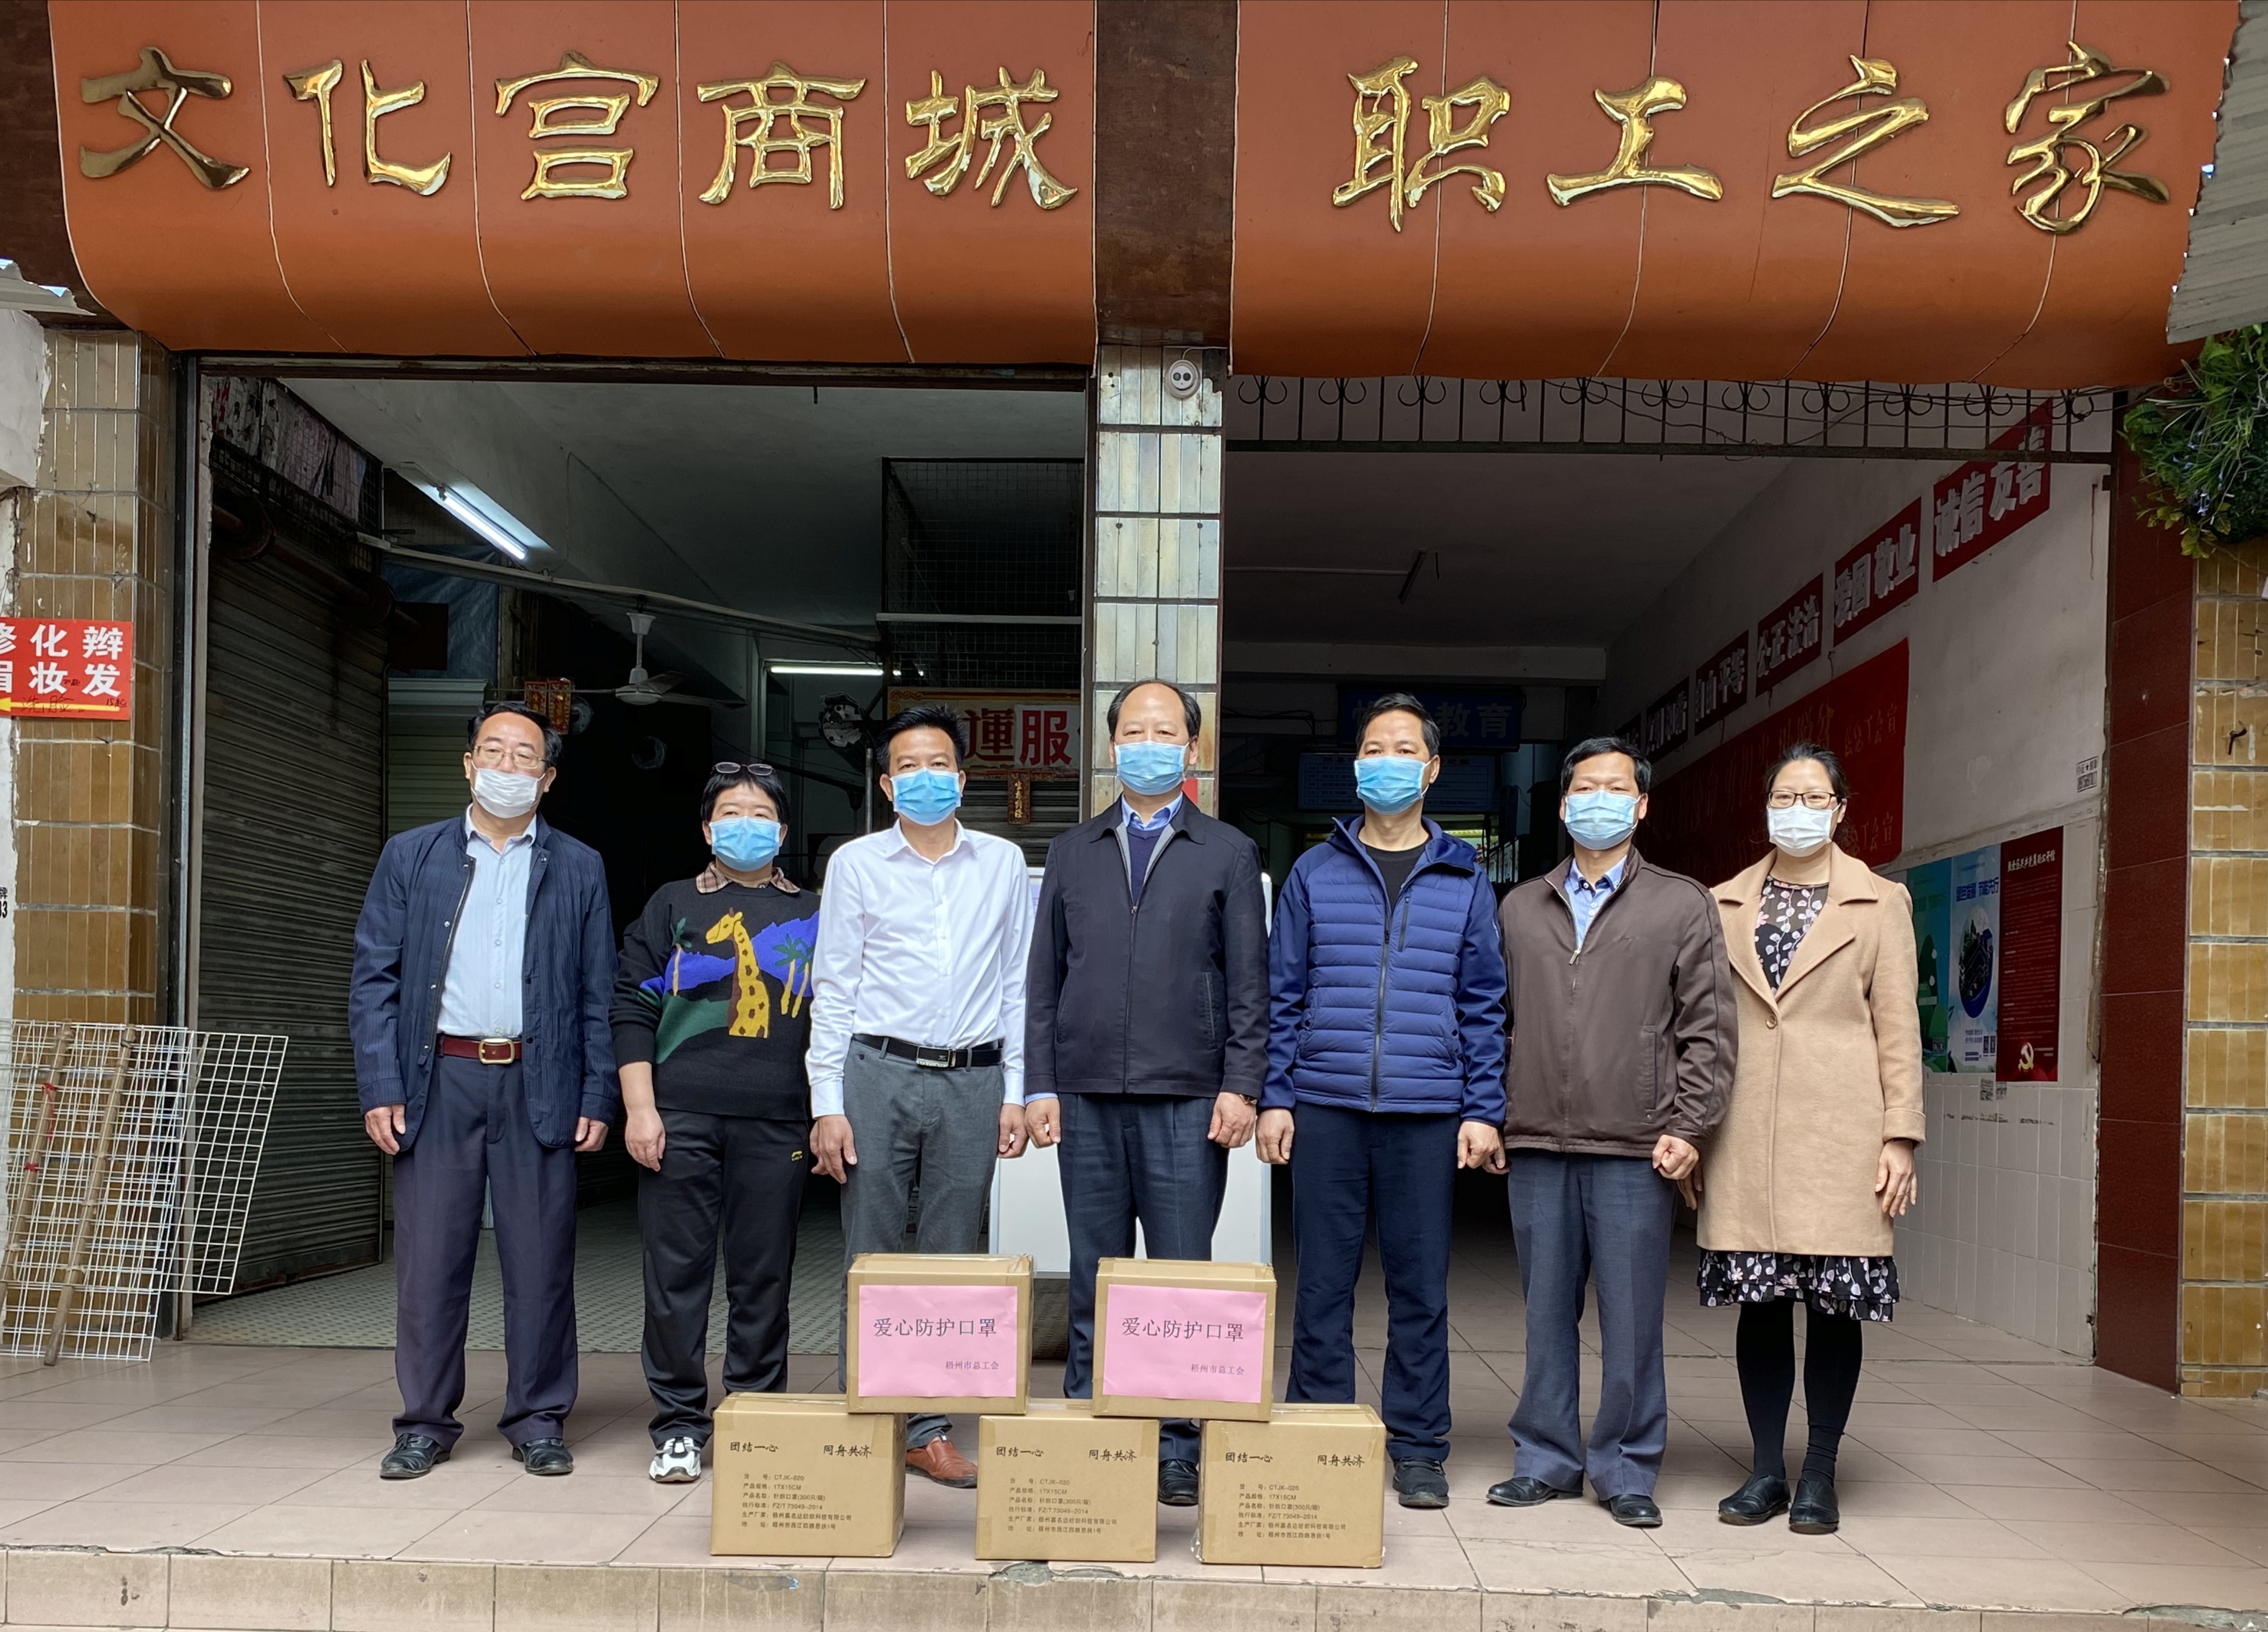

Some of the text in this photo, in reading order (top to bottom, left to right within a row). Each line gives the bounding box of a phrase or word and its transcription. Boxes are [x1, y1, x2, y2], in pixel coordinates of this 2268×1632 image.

[79, 45, 1078, 210] 文化宫商城
[1331, 39, 2172, 235] 职工之家
[873, 1316, 997, 1338] 爱心防护口罩
[1121, 1316, 1244, 1342] 爱心防护口罩
[945, 1360, 1000, 1370] 梧州市总工会
[1190, 1362, 1244, 1376] 梧州市总工会
[730, 1441, 872, 1458] 团结一心 同舟共济
[996, 1446, 1137, 1462] 团结一心 同舟共济
[1225, 1452, 1365, 1468] 团结一心 同舟共济
